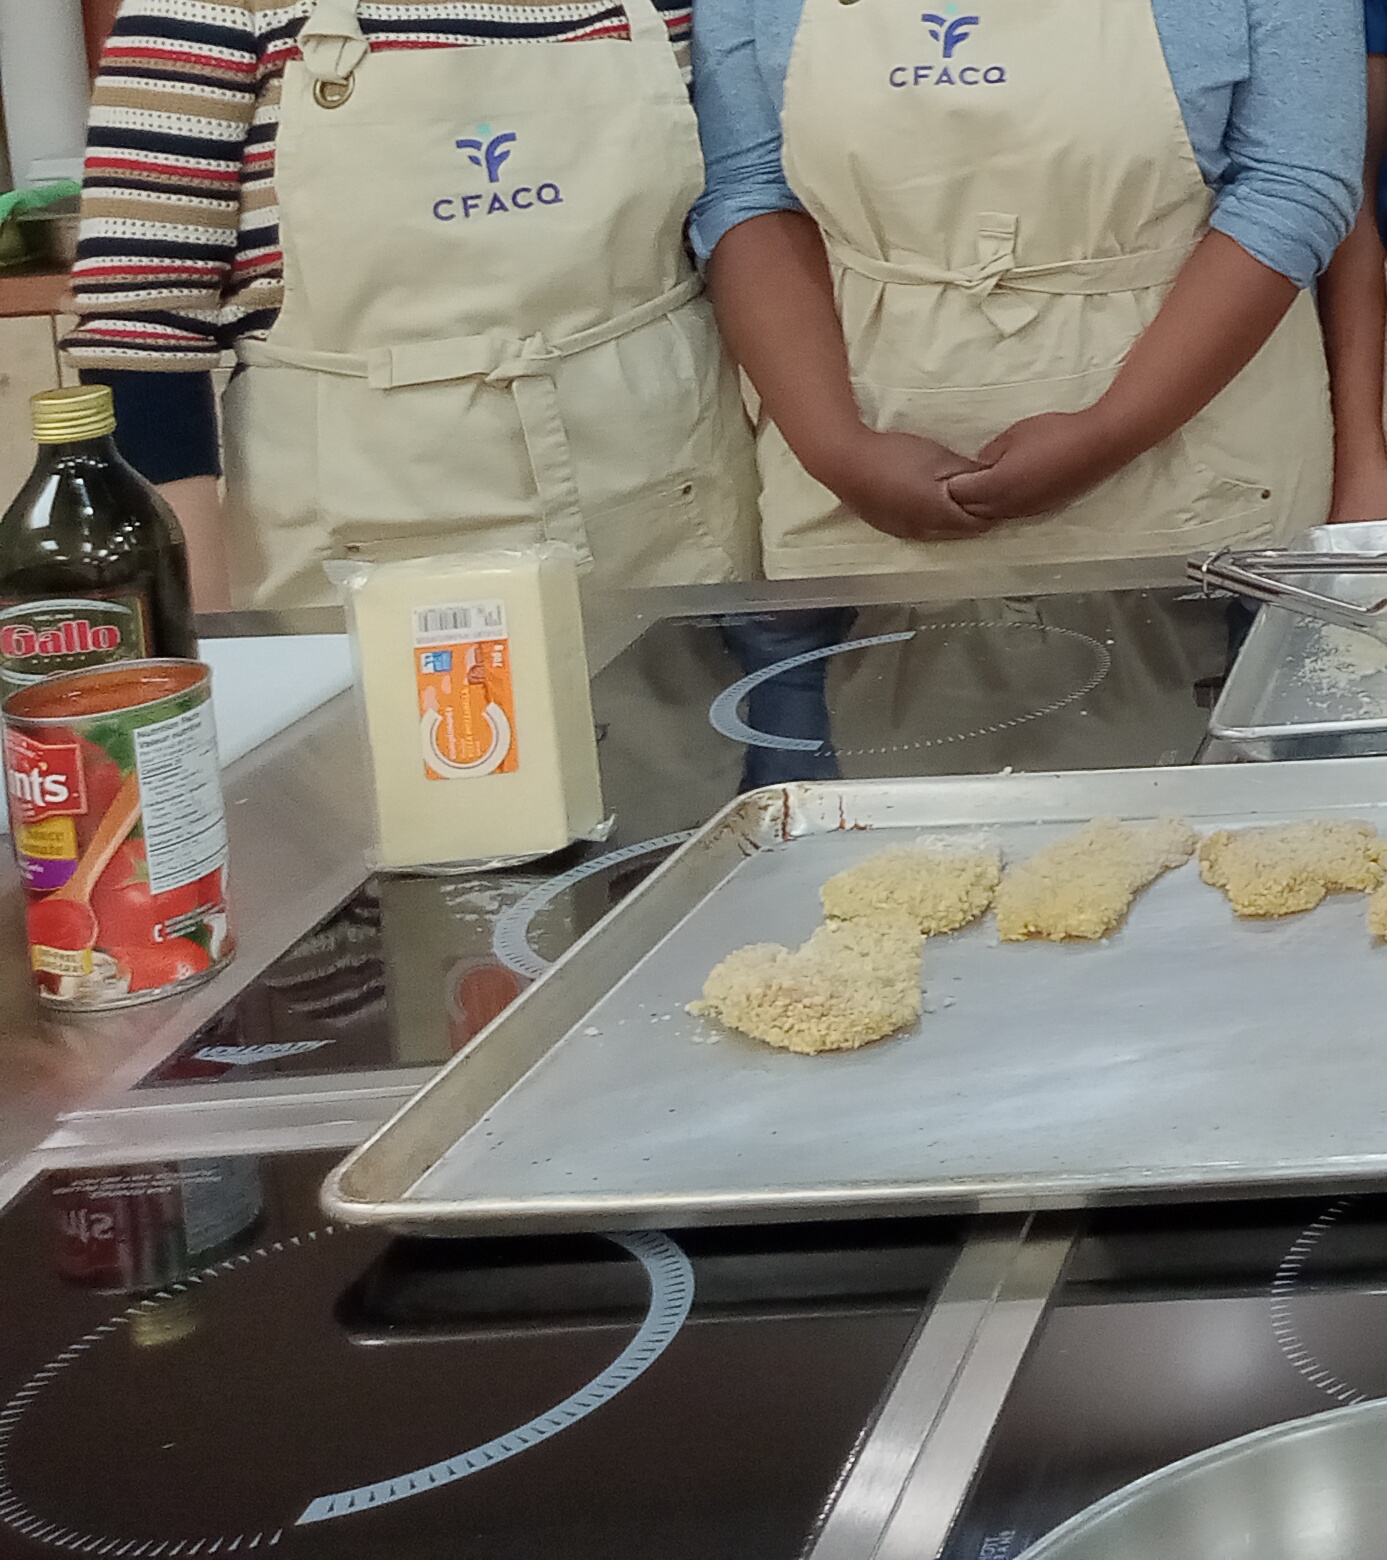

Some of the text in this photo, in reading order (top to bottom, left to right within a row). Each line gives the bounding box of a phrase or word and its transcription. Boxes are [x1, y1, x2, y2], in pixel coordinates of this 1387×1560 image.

[888, 65, 1008, 88] CFACQ
[433, 183, 564, 222] CFACQ
[1, 620, 120, 658] Gallo
